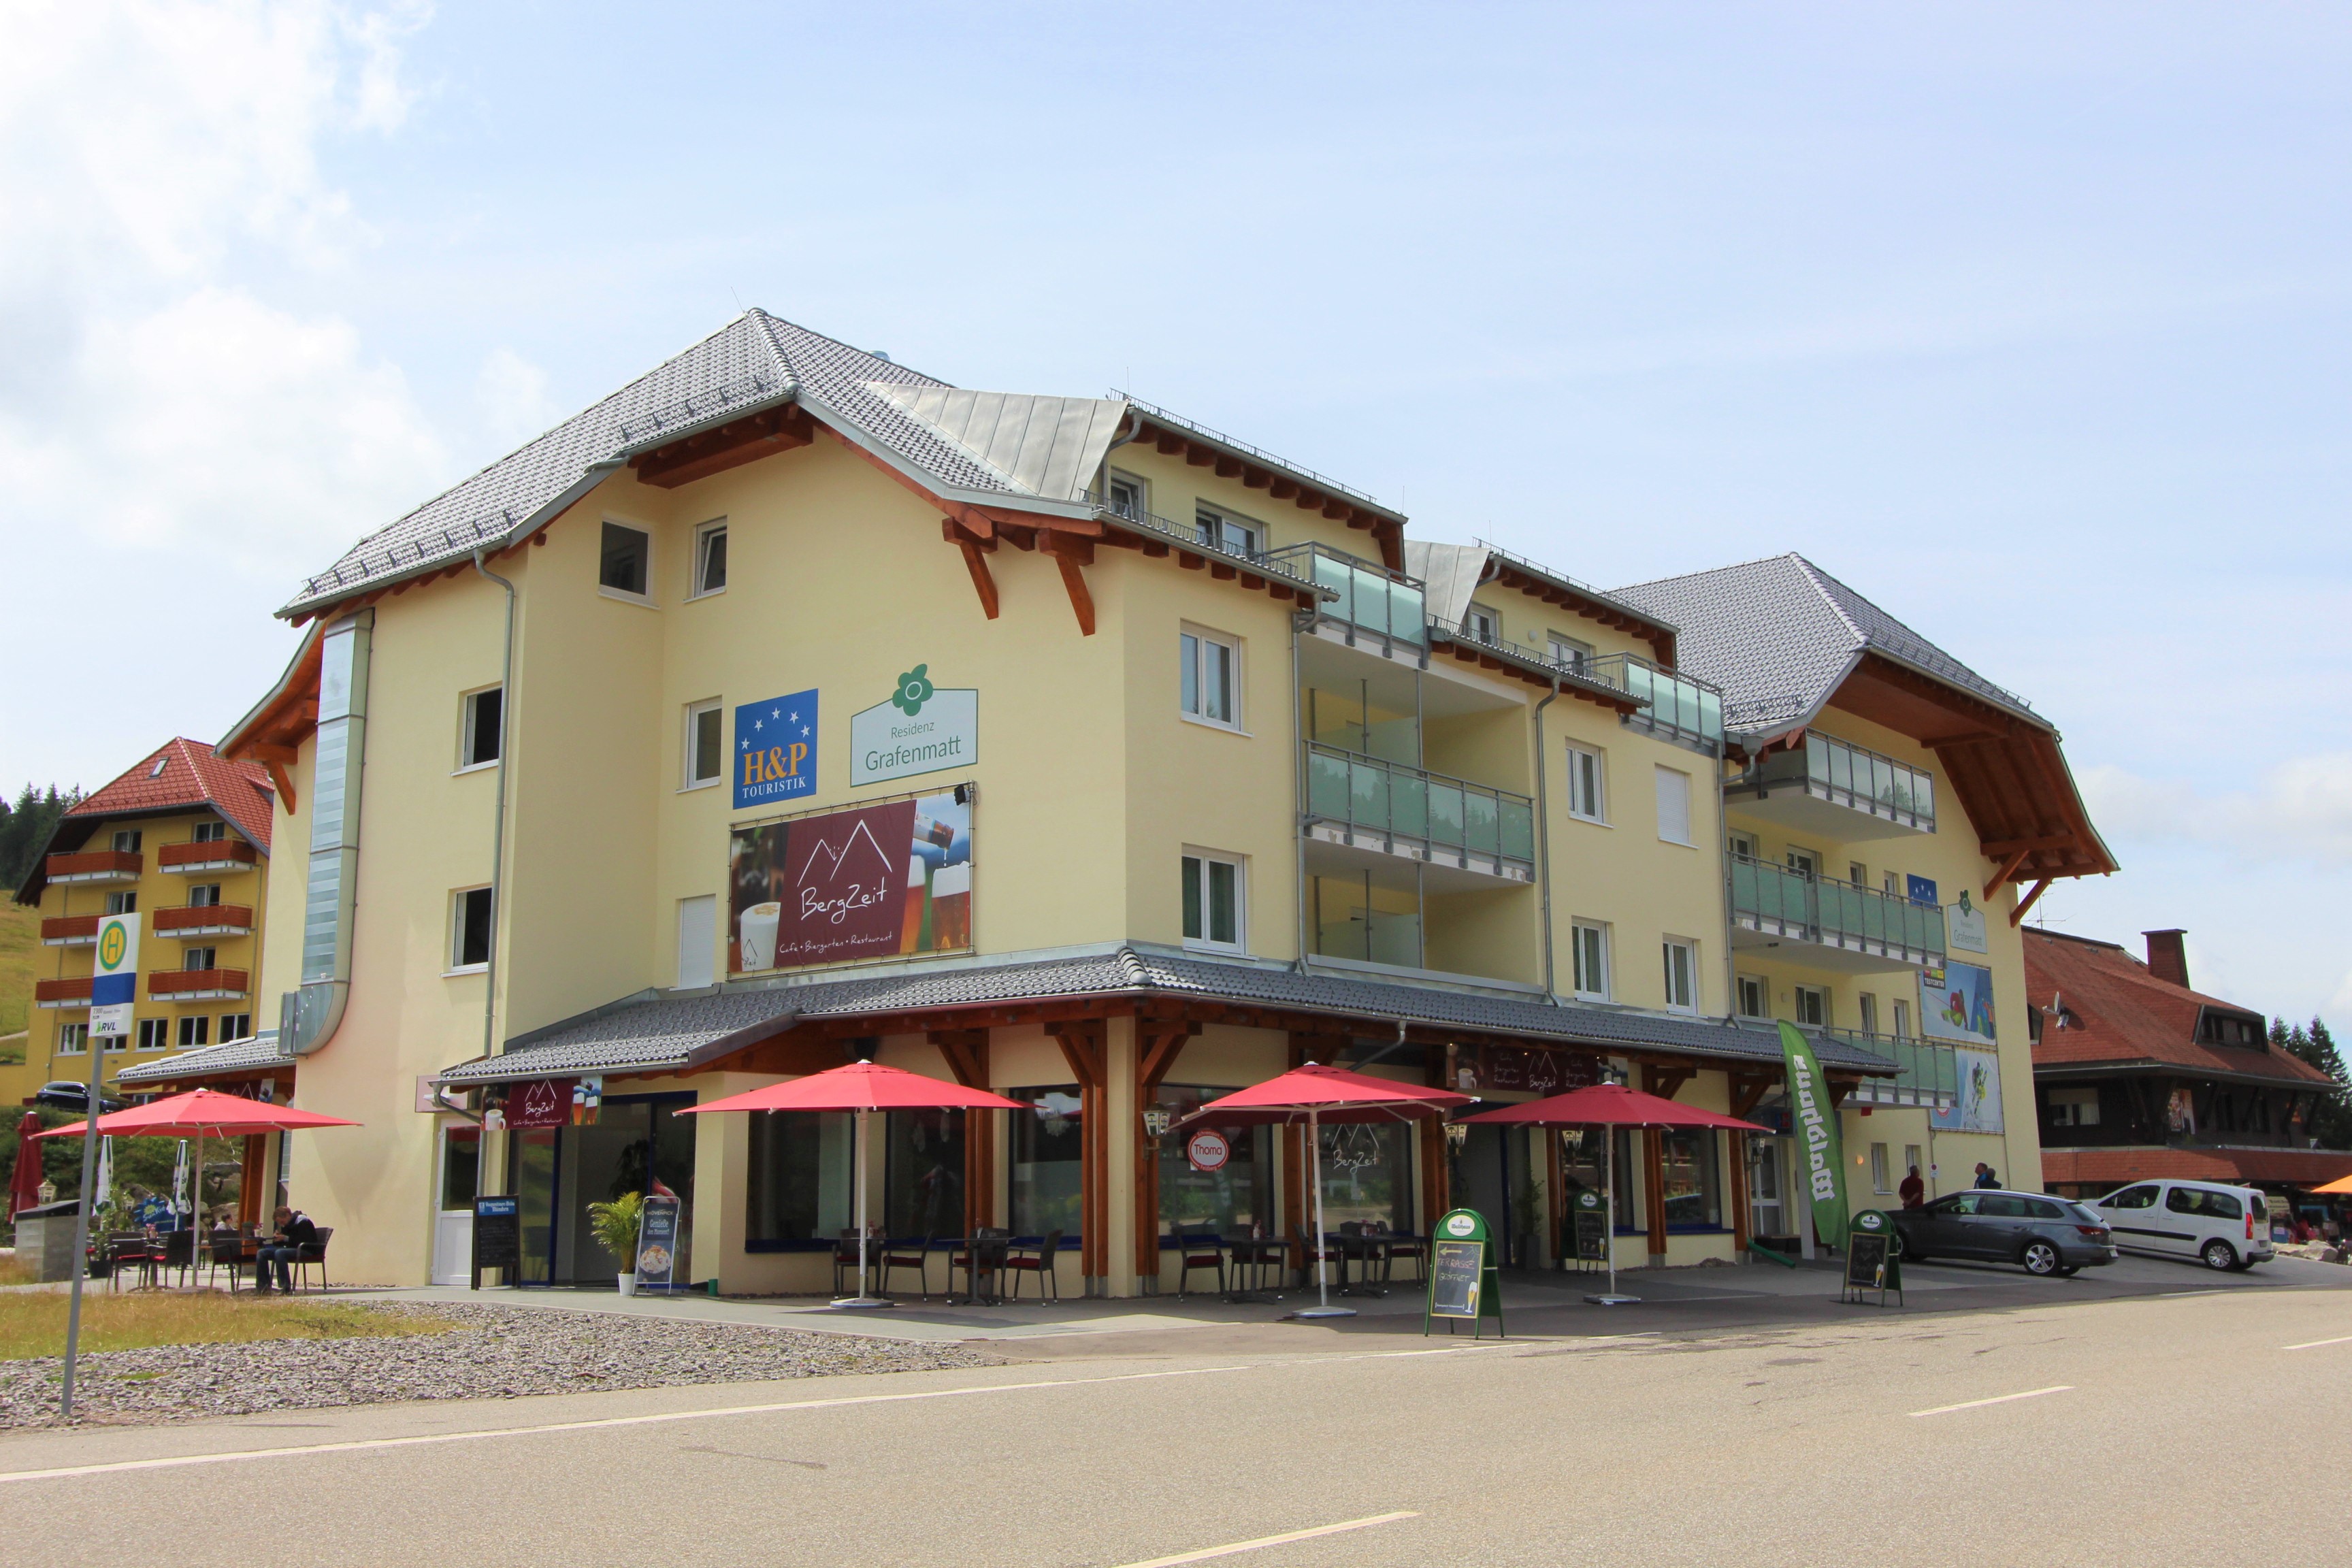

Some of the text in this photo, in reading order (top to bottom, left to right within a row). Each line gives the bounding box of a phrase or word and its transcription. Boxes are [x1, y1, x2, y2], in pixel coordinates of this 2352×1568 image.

[891, 721, 934, 739] Residenz
[742, 742, 807, 785] H&P
[866, 736, 961, 771] Grafenmatt
[742, 777, 806, 799] TOURISTIK
[800, 877, 887, 924] BergZeit
[107, 932, 120, 960] H
[779, 931, 893, 953] Cafe Biergarten Restaurant
[1924, 977, 1945, 987] TESTCENTER
[101, 1022, 116, 1032] RVL
[1529, 1074, 1556, 1092] BergZeit
[525, 1100, 555, 1117] BergZeit
[1793, 1055, 1835, 1203] Waldhaus
[1194, 1144, 1222, 1156] Thoma
[1333, 1149, 1377, 1175] BergZeit
[1437, 1258, 1475, 1269] TERRASSE
